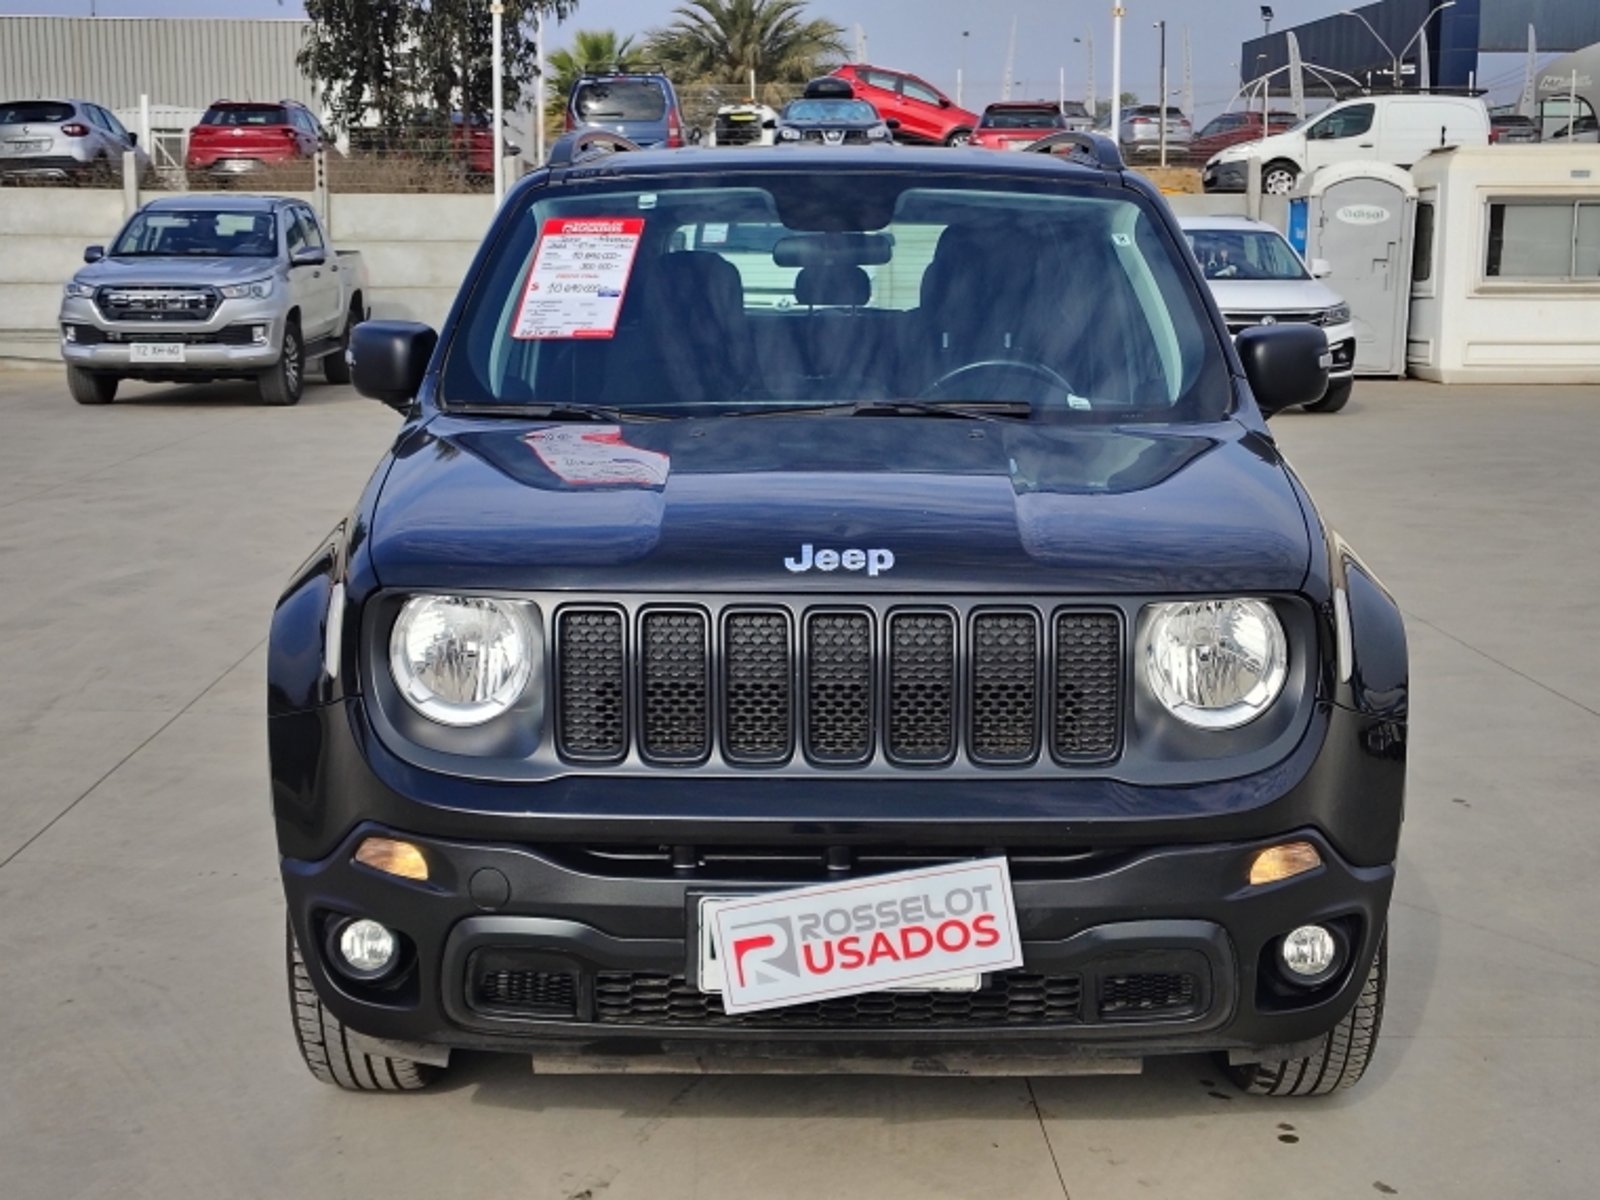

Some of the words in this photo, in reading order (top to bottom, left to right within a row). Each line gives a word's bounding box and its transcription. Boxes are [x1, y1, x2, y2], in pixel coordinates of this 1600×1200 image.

[784, 543, 895, 577] Jeep
[799, 884, 993, 941] ROSSELOT
[803, 914, 1001, 976] USADOS
